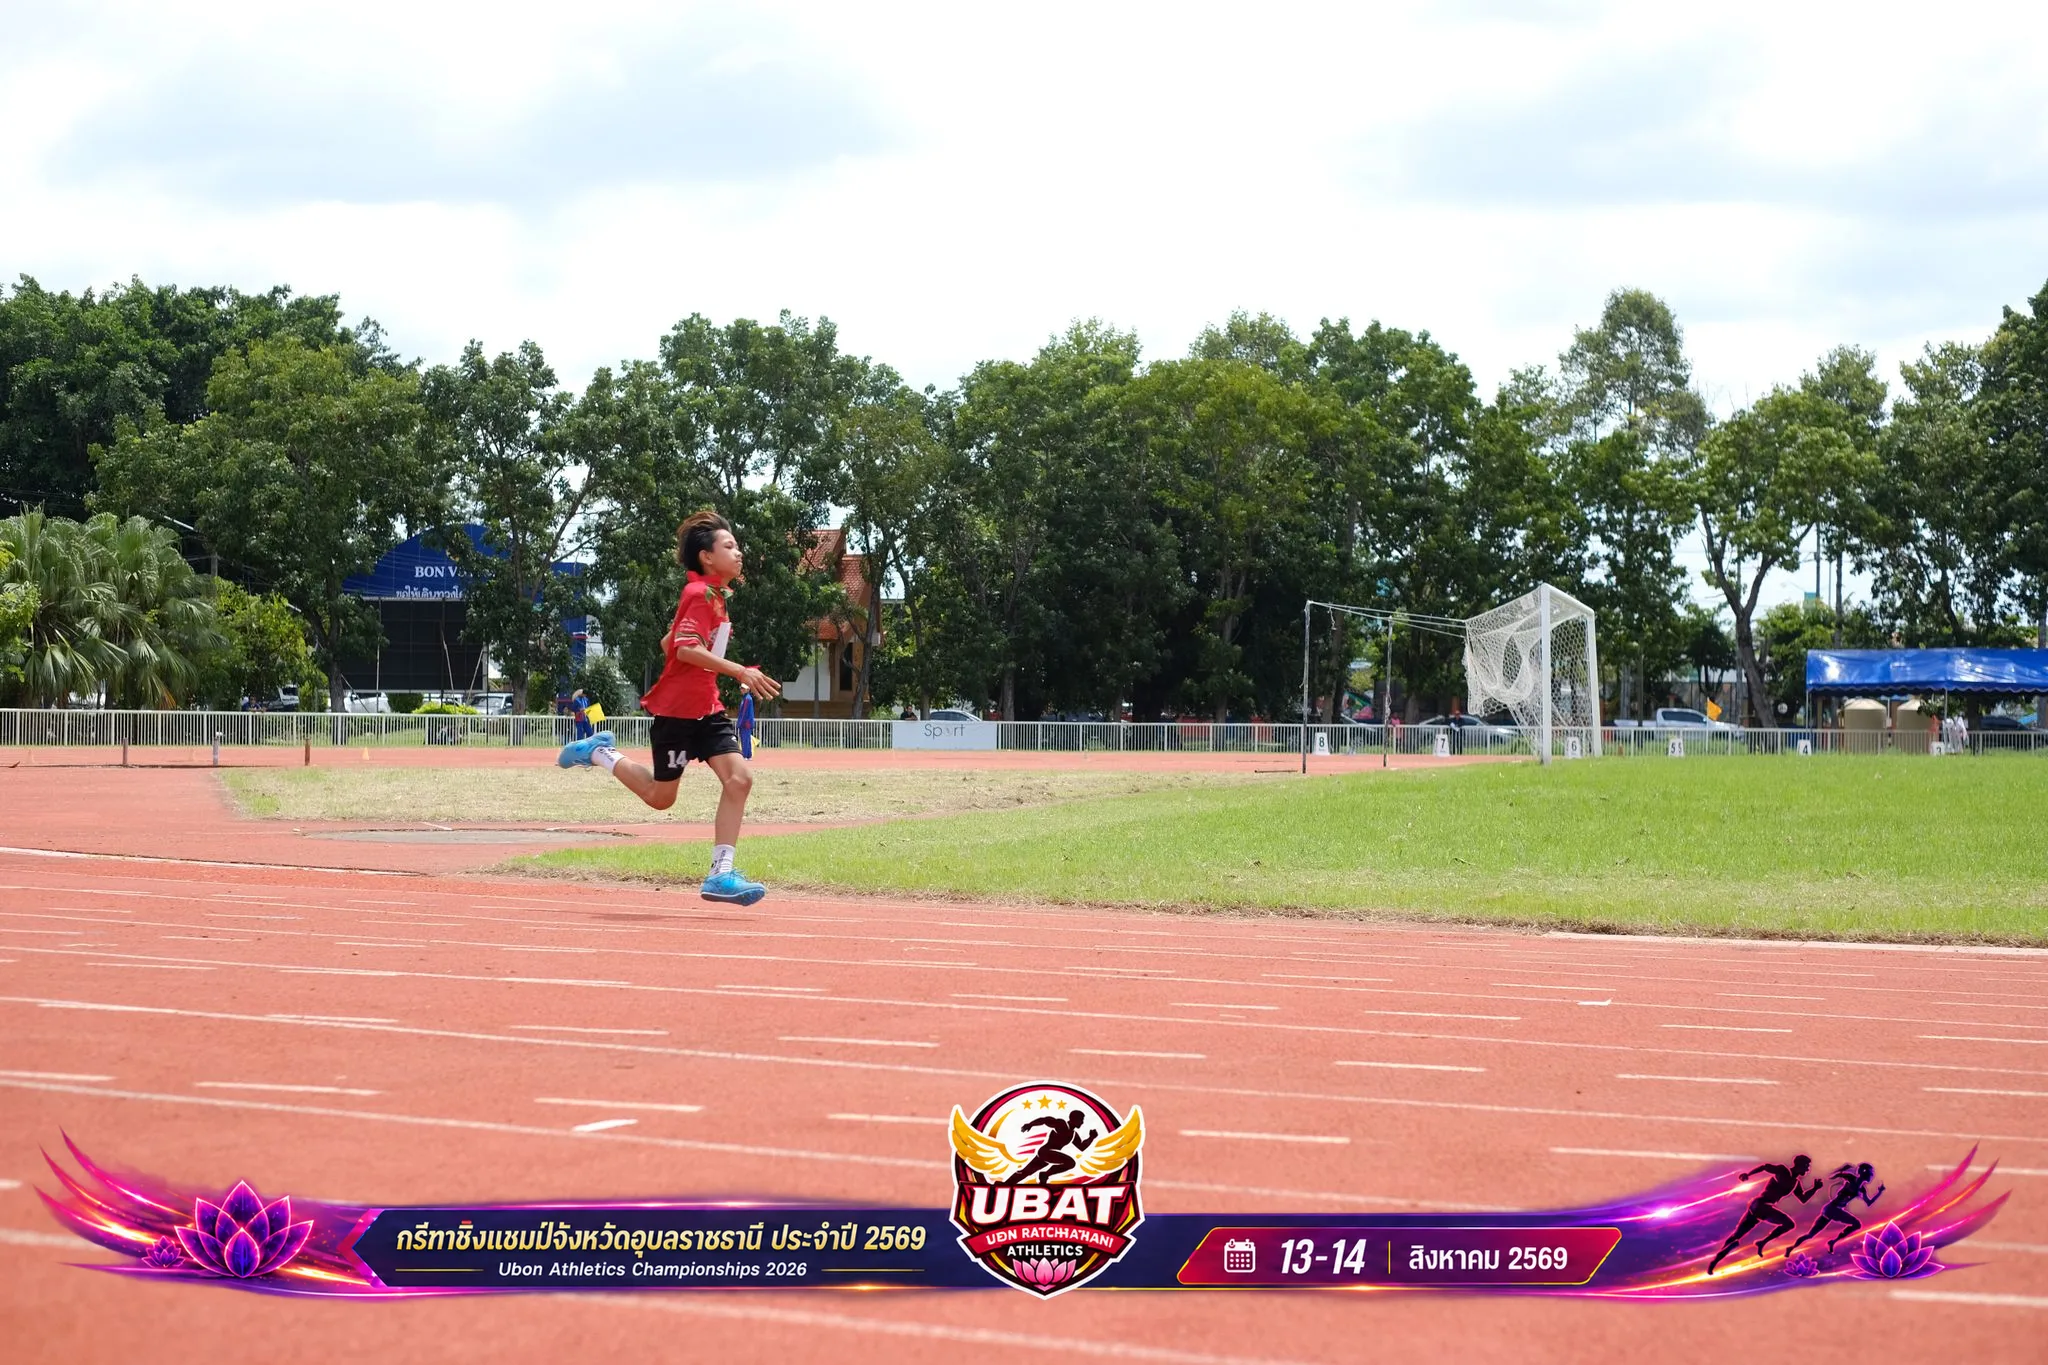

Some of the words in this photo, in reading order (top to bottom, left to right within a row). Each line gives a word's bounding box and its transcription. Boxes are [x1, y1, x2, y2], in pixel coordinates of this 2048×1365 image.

[414, 566, 445, 578] BON
[1318, 736, 1325, 748] 8
[1440, 737, 1446, 749] 7
[1571, 740, 1578, 752] 6
[1670, 742, 1676, 754] 5
[667, 750, 688, 768] 14
